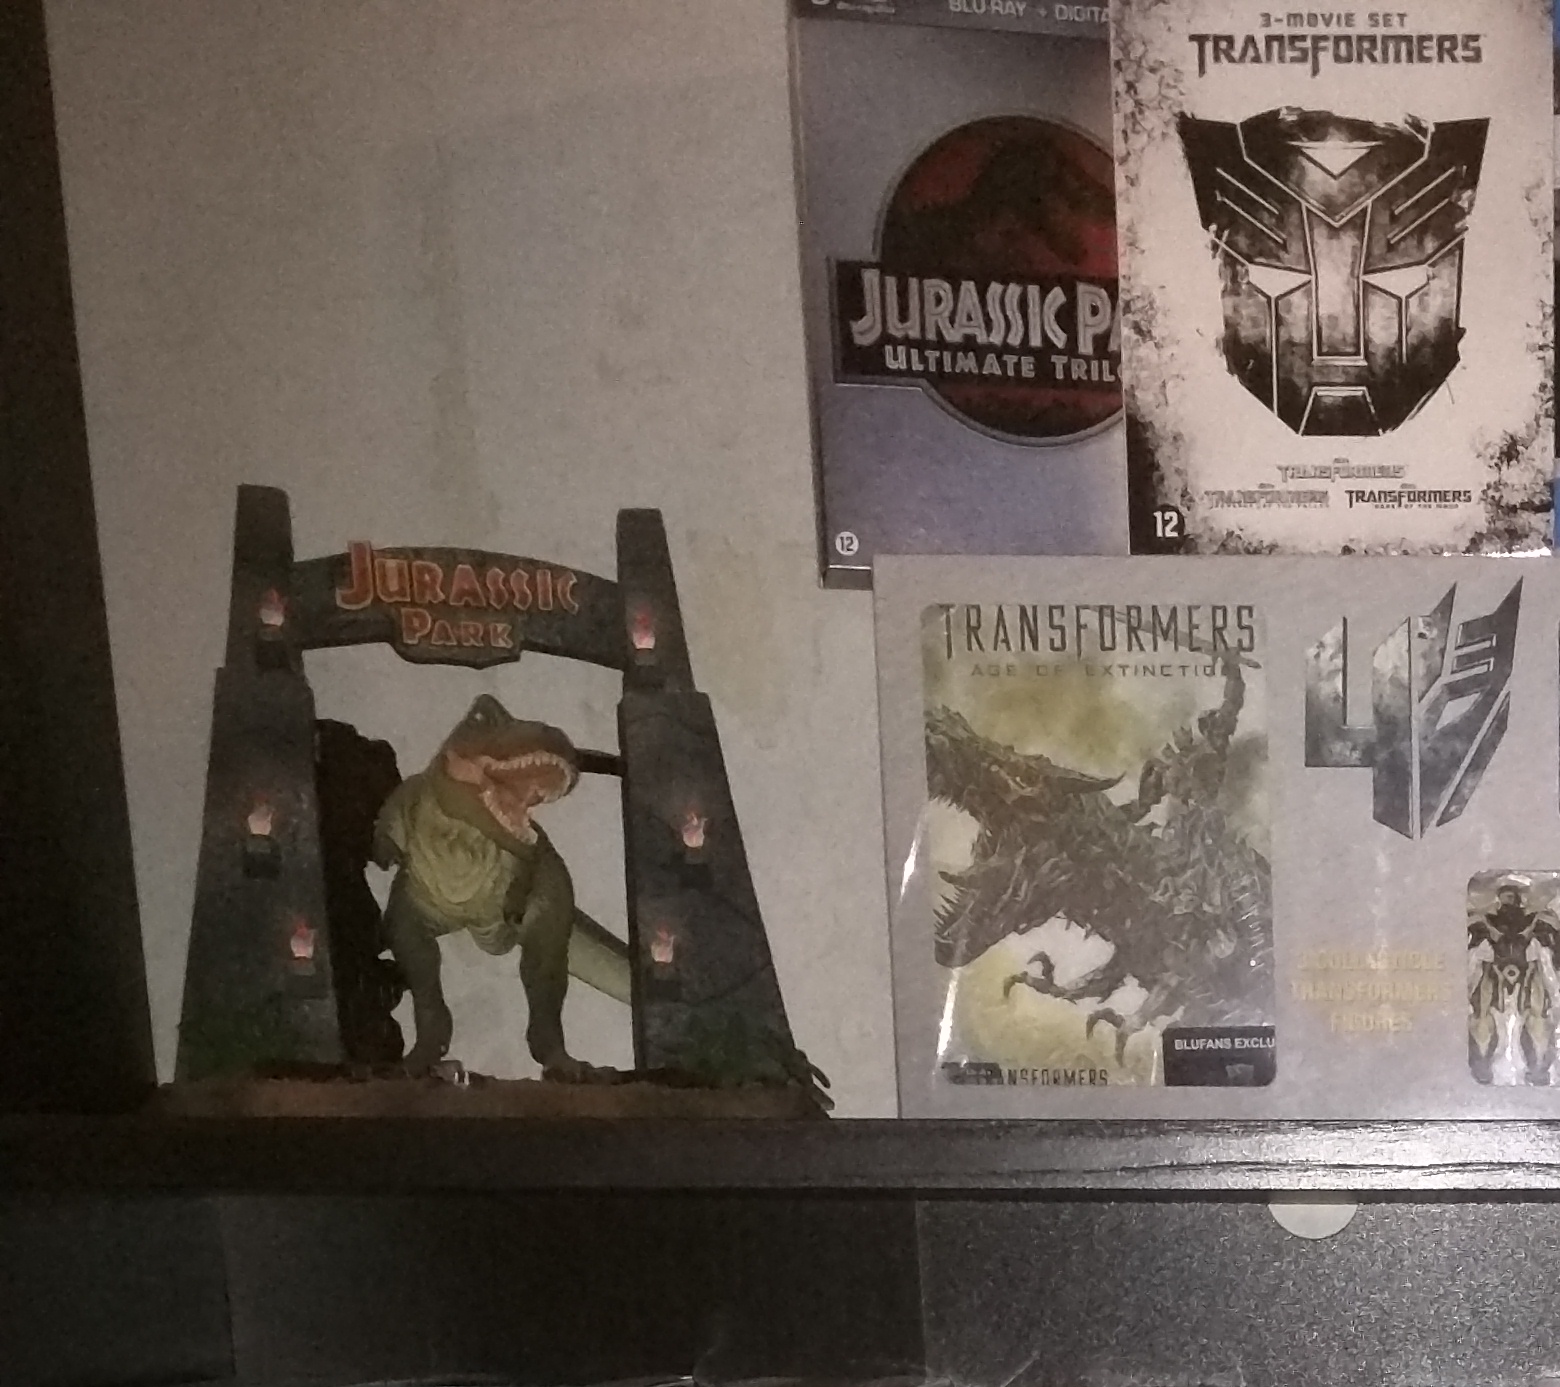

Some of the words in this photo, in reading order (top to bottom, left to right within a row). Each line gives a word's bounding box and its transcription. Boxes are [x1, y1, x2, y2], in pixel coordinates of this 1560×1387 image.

[1260, 11, 1354, 28] 3-MOVIE
[1366, 12, 1407, 28] SET
[1189, 33, 1484, 78] TRANSFORMERS
[850, 267, 1067, 353] JURASSIC
[884, 344, 1036, 381] ULTIMATE
[1345, 489, 1472, 509] TRANSFORMERS
[1153, 511, 1178, 537] 12
[836, 536, 856, 552] 12
[335, 540, 578, 612] JURASSIC
[402, 608, 514, 648] PARK
[937, 603, 1256, 660] TRANSFORMERS
[971, 663, 1018, 678] AGE
[1085, 663, 1222, 679] EXTINCTIO
[1174, 1037, 1231, 1051] BLUFANS
